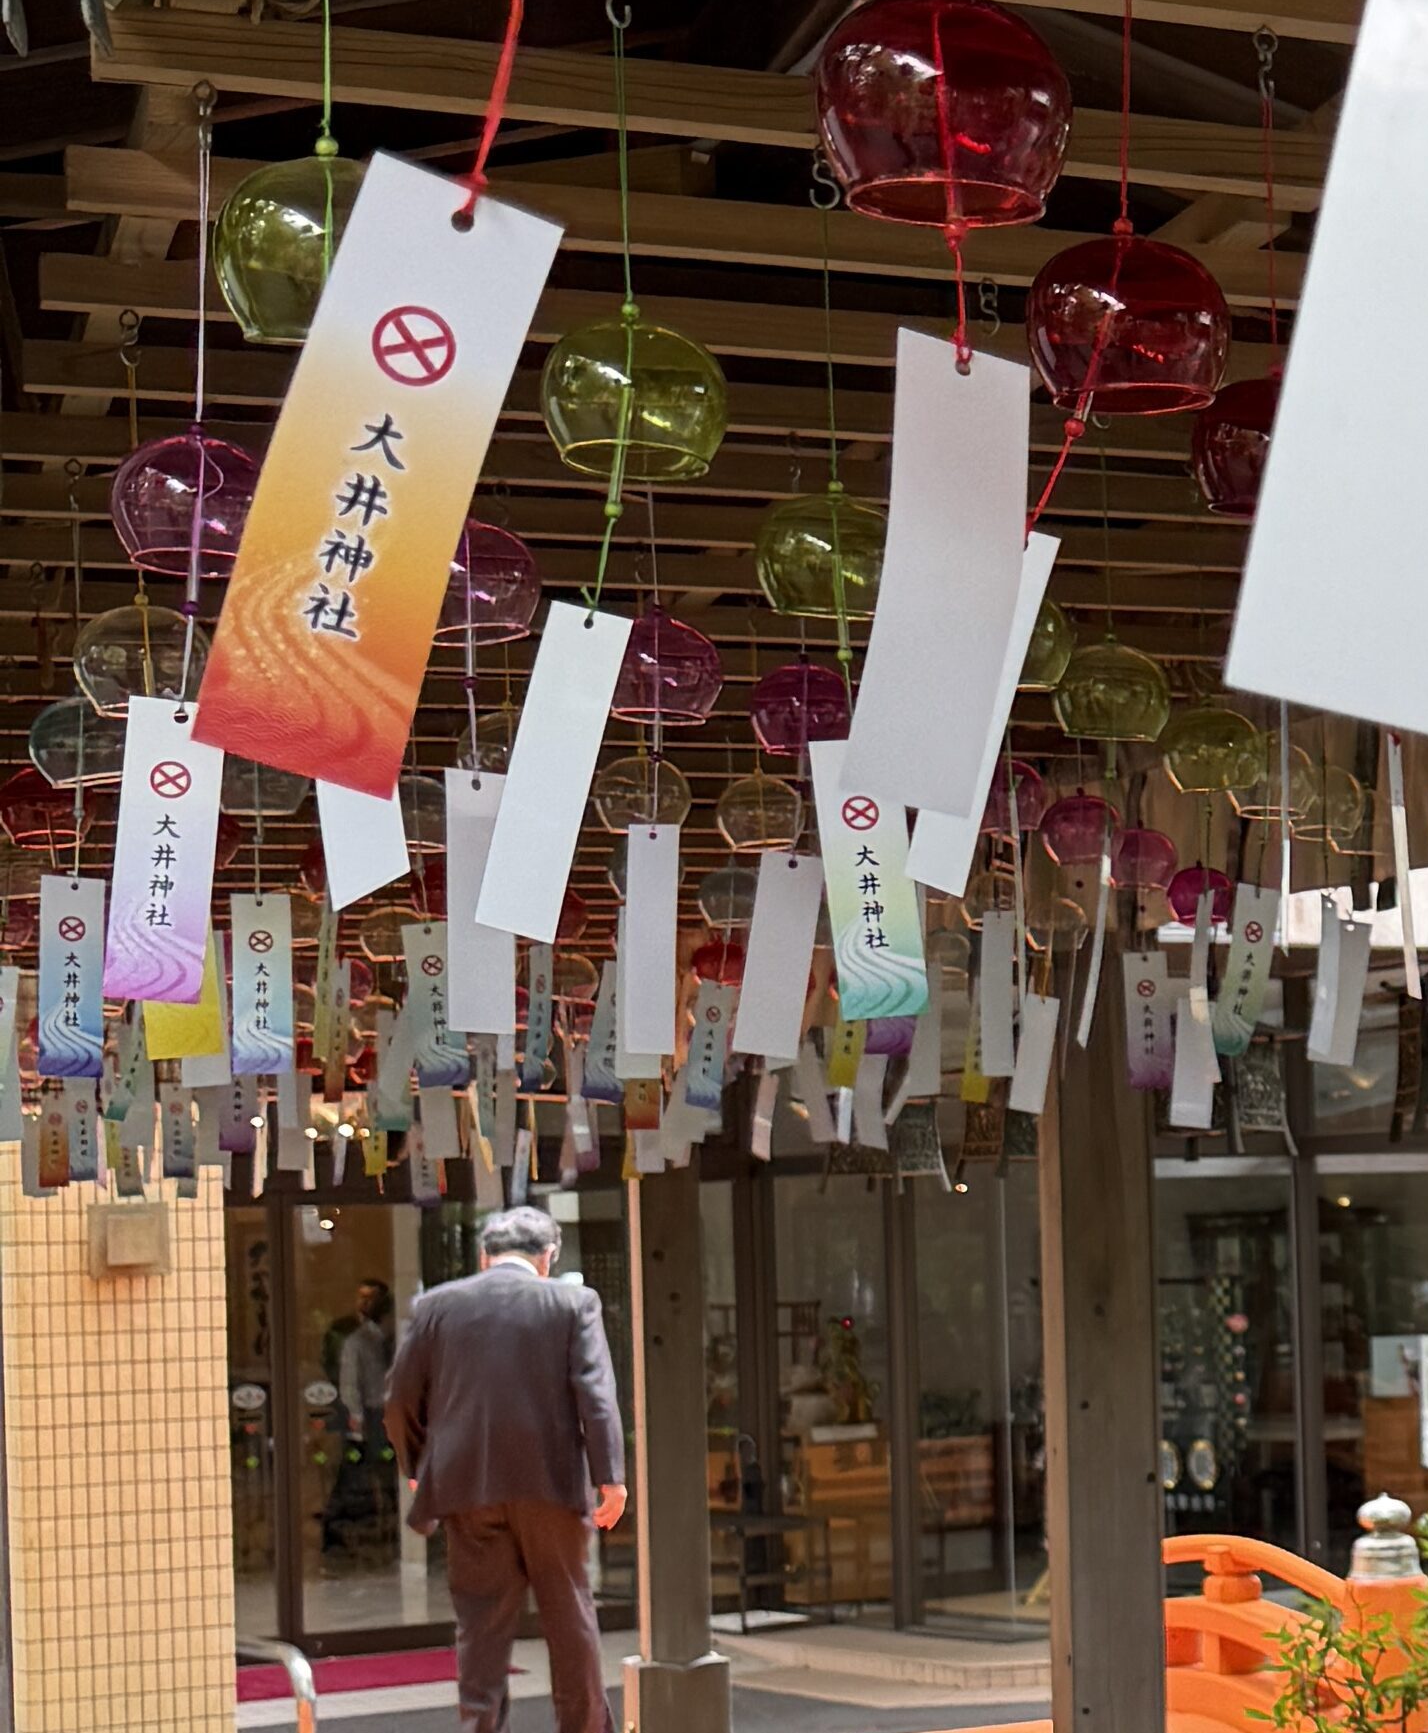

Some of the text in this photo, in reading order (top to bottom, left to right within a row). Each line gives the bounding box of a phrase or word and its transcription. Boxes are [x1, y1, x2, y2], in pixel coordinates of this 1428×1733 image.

[302, 413, 406, 641] 大井神社
[145, 815, 181, 928] 大井神社
[854, 844, 889, 949] 大井神社
[64, 952, 80, 1027] 大井神社
[255, 962, 270, 1030] 大井神社
